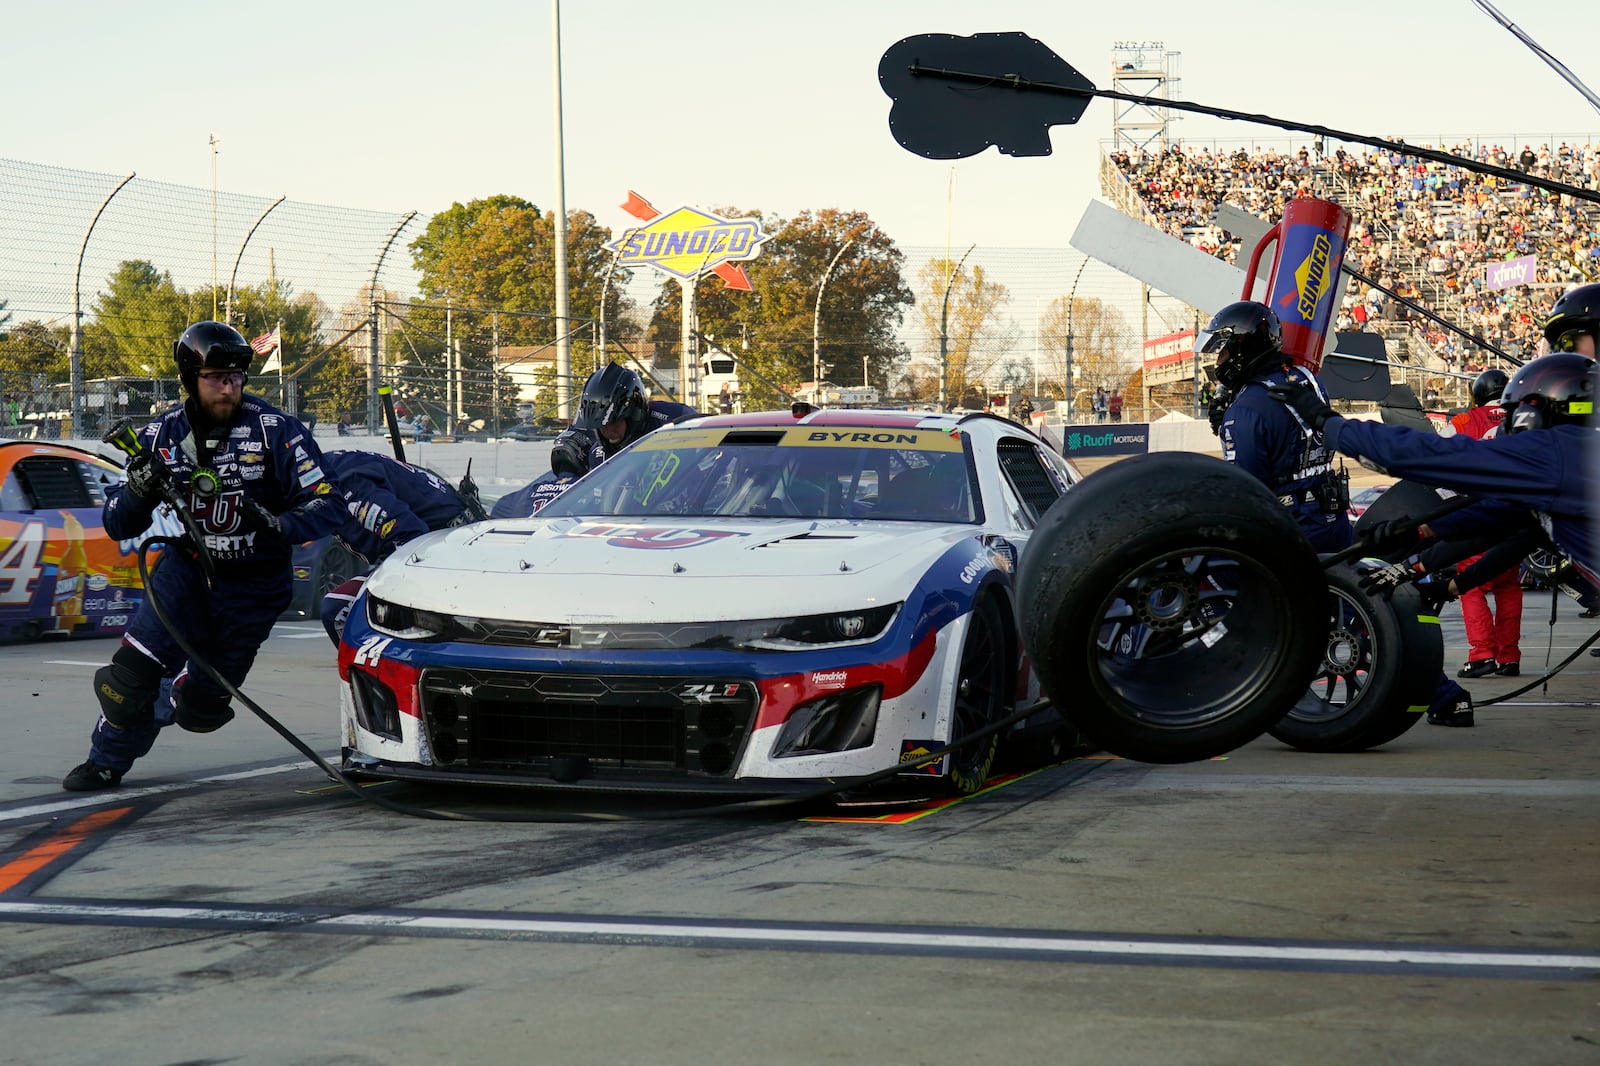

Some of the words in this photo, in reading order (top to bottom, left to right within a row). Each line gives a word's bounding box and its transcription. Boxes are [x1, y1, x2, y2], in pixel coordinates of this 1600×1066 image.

[622, 227, 751, 258] SUNOCO
[1299, 237, 1330, 317] SUNOCO
[1493, 261, 1528, 287] xfinity
[807, 432, 918, 444] BYRON
[1083, 432, 1114, 447] Ruoff
[1114, 434, 1145, 444] MORTGAGE
[205, 530, 256, 552] ERTY
[211, 547, 254, 560] ERSITY
[101, 615, 128, 627] FORD
[353, 635, 394, 667] 24
[812, 671, 848, 682] Hendrick
[679, 683, 741, 697] ZL1
